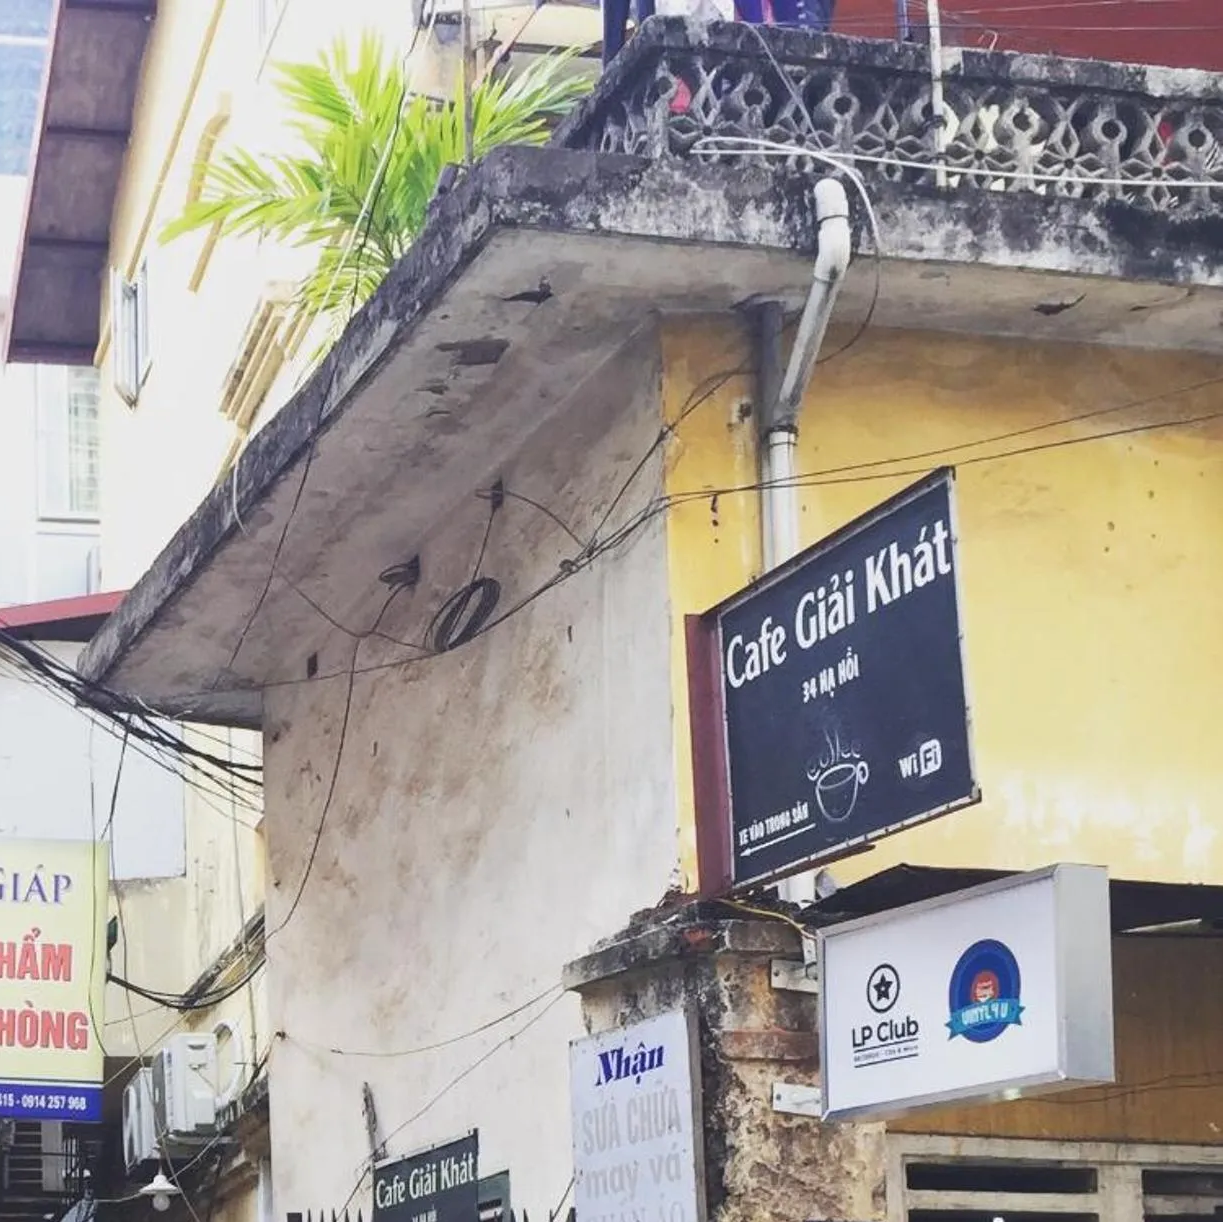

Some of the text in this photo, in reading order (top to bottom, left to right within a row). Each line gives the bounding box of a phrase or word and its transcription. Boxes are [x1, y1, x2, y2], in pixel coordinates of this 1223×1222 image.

[726, 519, 952, 689] Cafe Giải Khát
[802, 677, 817, 703] 34
[852, 1015, 919, 1048] LP Club
[594, 1041, 665, 1087] Nhận
[21, 1093, 46, 1109] 0914
[47, 1095, 66, 1110] 257
[68, 1096, 87, 1111] 968
[376, 1151, 474, 1209] Cafe Giải Khát
